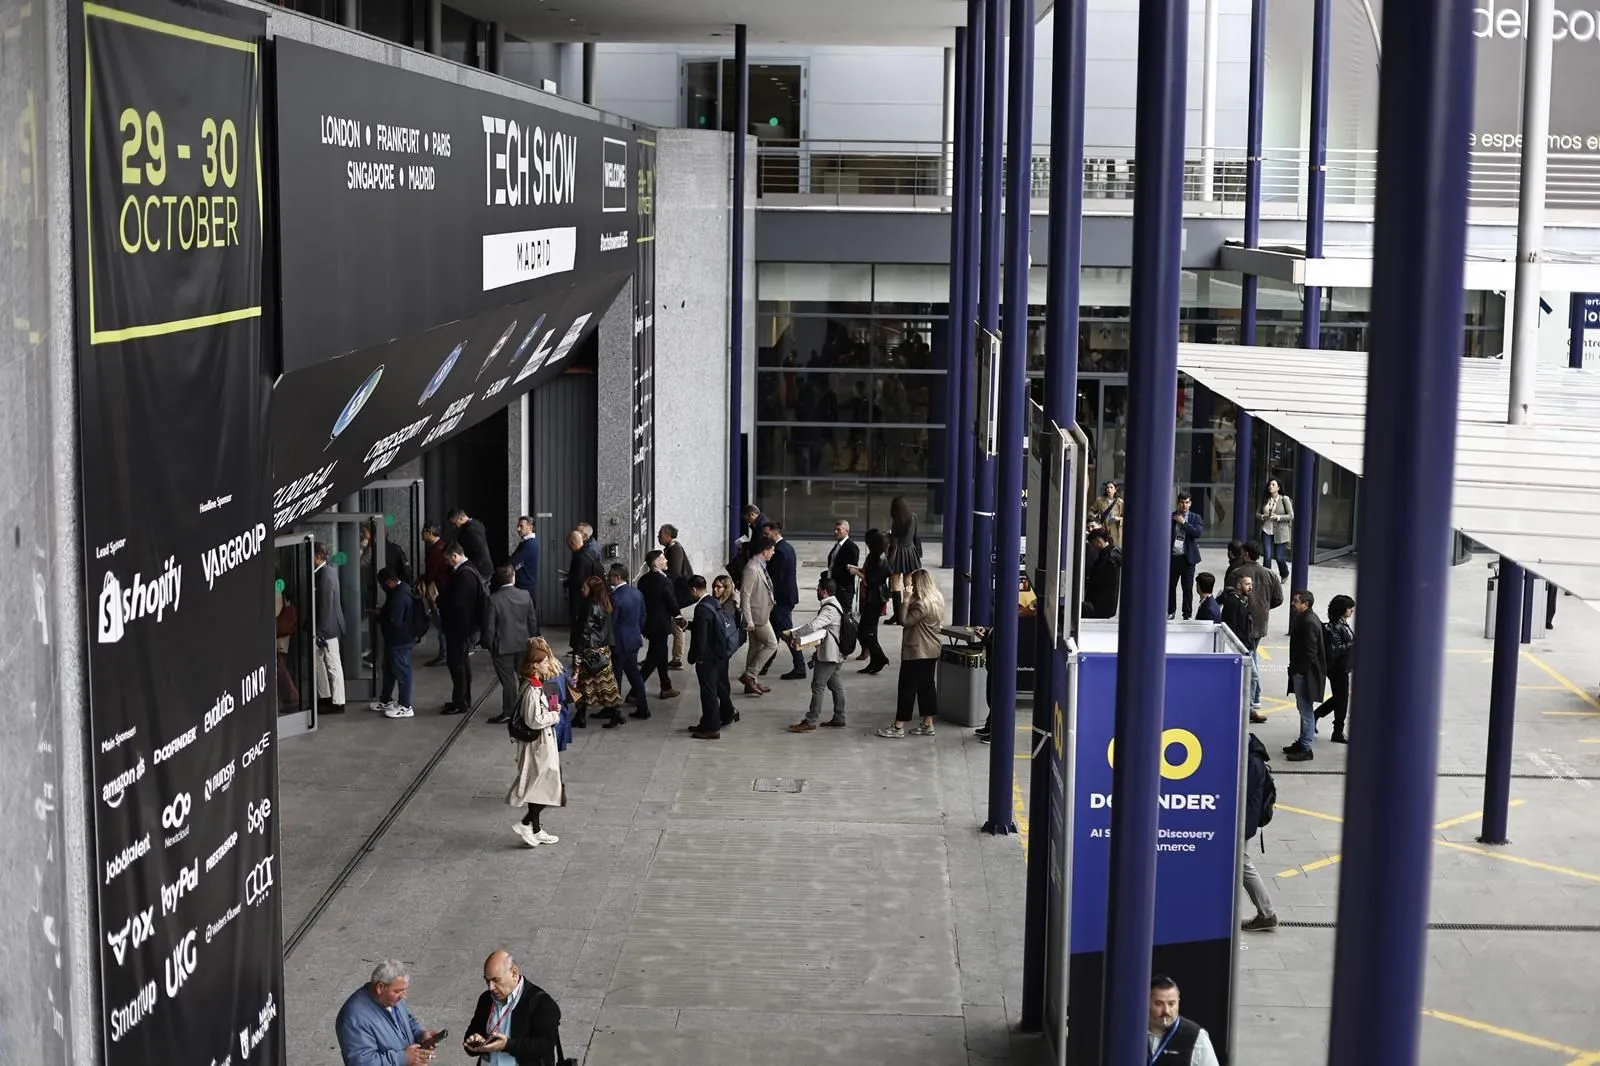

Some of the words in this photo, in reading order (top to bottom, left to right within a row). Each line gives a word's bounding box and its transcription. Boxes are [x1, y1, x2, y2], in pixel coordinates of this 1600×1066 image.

[119, 107, 166, 186] 29
[177, 144, 191, 159] -
[201, 117, 238, 189] 30
[321, 114, 361, 148] LONDON
[377, 123, 420, 154] FRANKFURT
[432, 131, 451, 157] PARIS
[347, 160, 395, 190] SINGAPORE
[408, 165, 435, 190] MADRID
[482, 115, 530, 207] TECH
[533, 126, 577, 206] SHOW
[119, 194, 239, 253] OCTOBER
[516, 239, 551, 271] MADRID
[96, 545, 110, 559] Lead
[201, 523, 266, 591] VARGROUP
[122, 555, 182, 623] shopify
[101, 738, 116, 753] Main
[102, 767, 136, 802] amazon
[164, 824, 190, 848] Nextcloud
[247, 798, 271, 835] Sage
[1090, 828, 1102, 838] AI
[1158, 828, 1215, 840] Discovery
[105, 832, 151, 884] job&talent
[161, 857, 198, 916] PayPal
[165, 929, 197, 998] UKG
[111, 979, 157, 1042] Smartup
